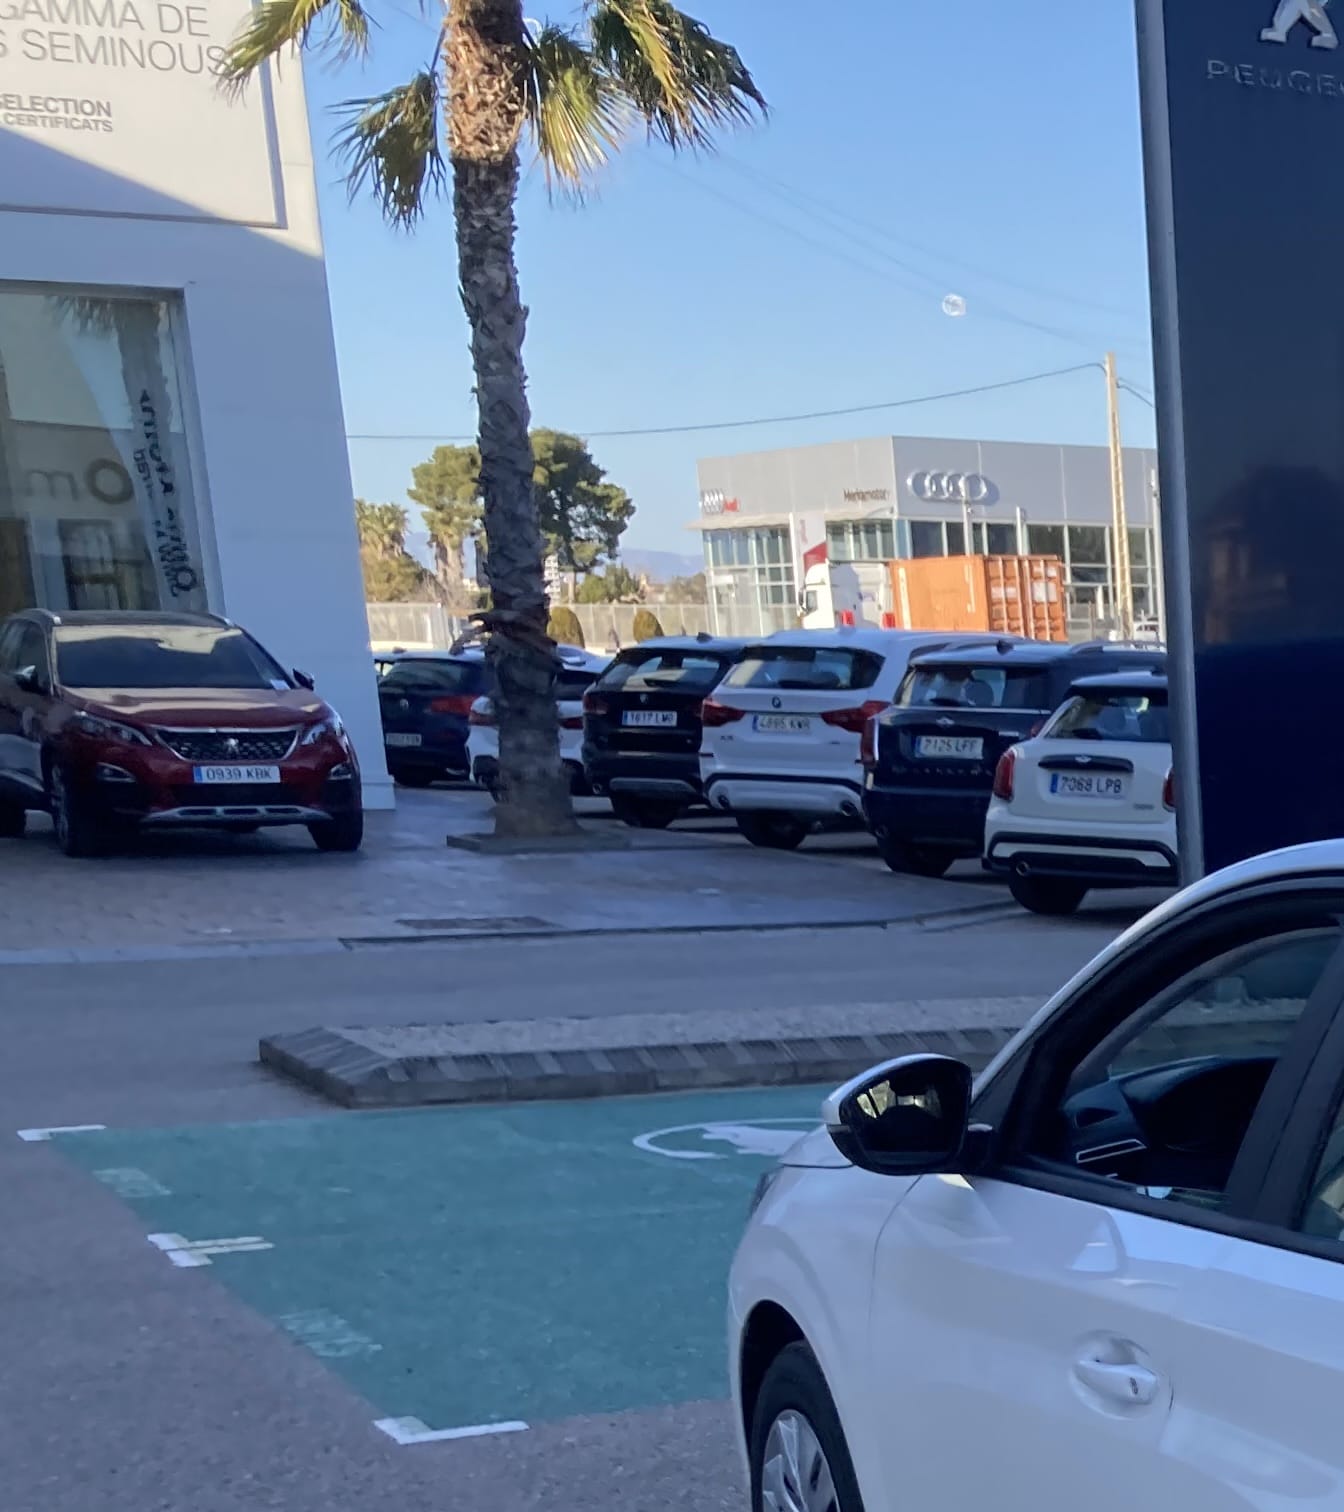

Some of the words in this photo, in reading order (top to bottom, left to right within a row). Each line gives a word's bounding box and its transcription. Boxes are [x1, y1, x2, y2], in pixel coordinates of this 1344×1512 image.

[157, 3, 210, 37] DE
[21, 28, 229, 77] SEMINOUS
[0, 93, 112, 118] ELECTION
[3, 112, 113, 132] CERTIFICATS
[206, 767, 241, 780] 0939
